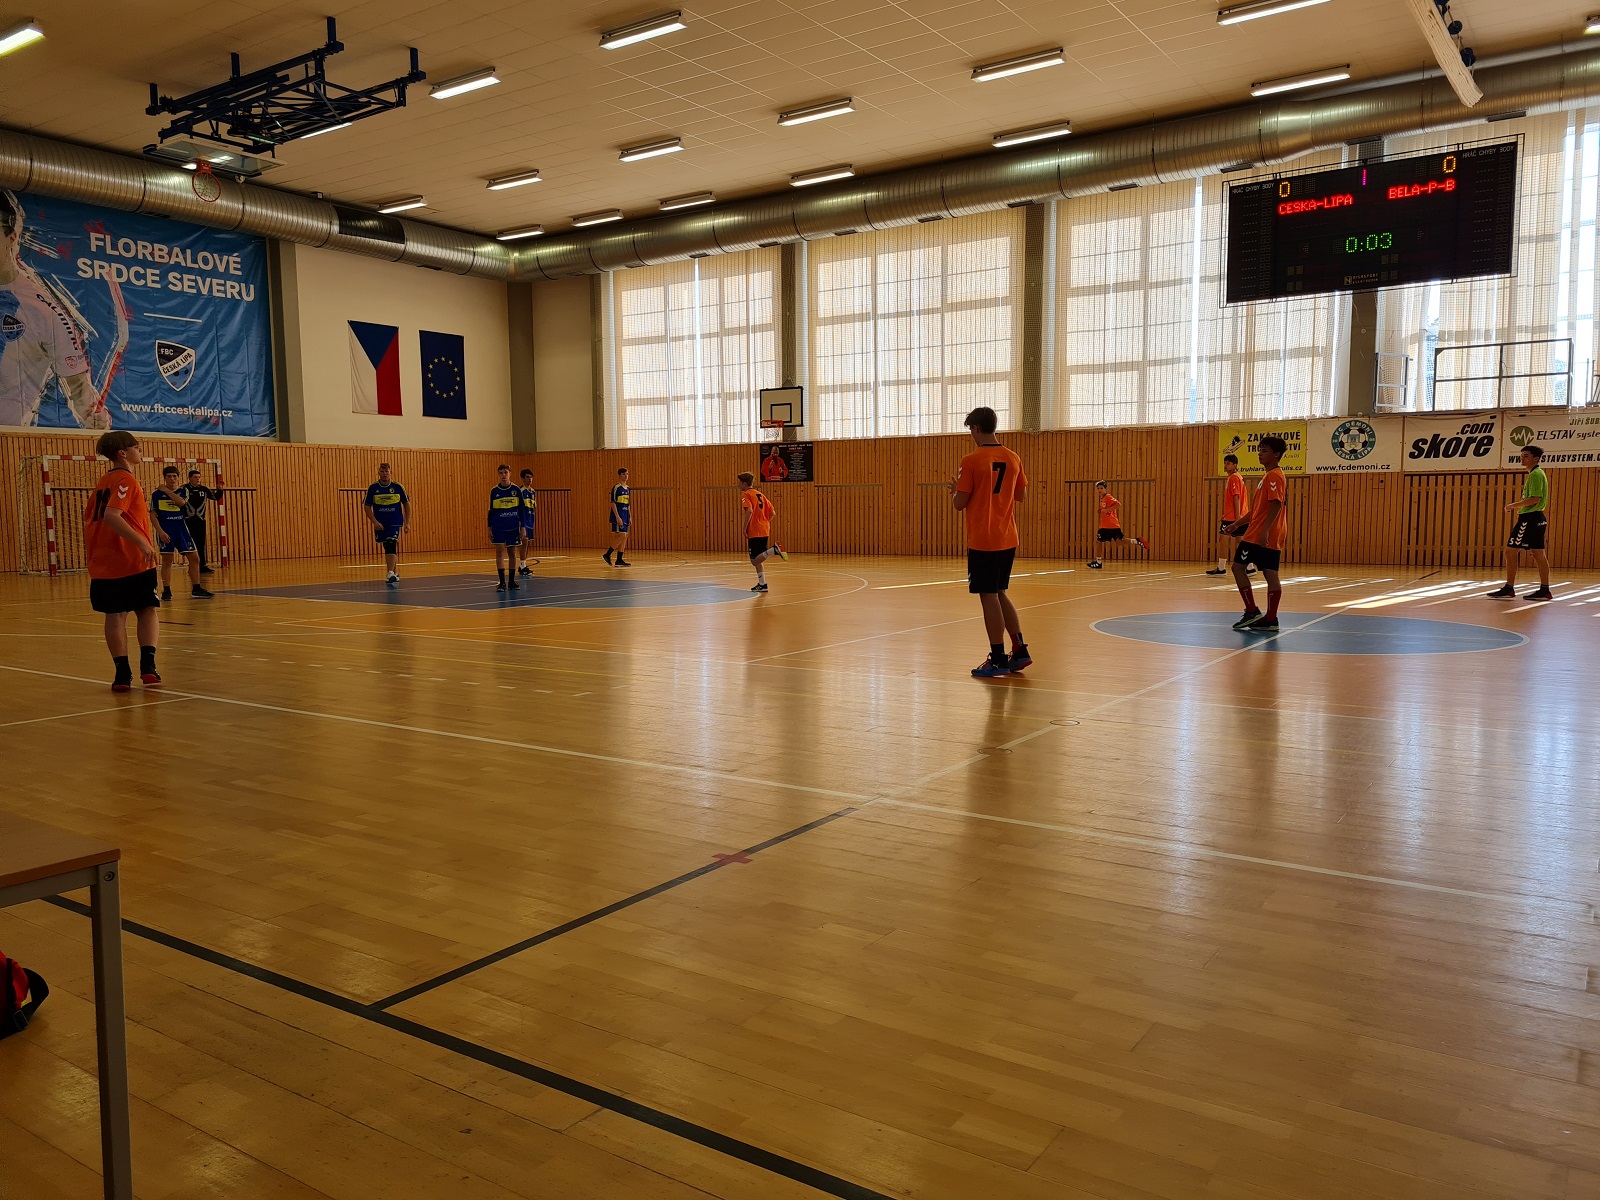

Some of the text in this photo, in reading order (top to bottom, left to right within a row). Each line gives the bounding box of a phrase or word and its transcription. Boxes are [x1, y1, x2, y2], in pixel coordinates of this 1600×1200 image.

[1443, 155, 1457, 174] 0
[1278, 181, 1291, 198] 0
[1387, 178, 1457, 200] BELA-P-B
[1278, 193, 1354, 215] CESKA-LIPA
[1345, 231, 1393, 253] 0:03
[89, 231, 243, 276] FLORBALOVÉ
[76, 257, 256, 302] SRDCE SEVERU
[160, 347, 174, 356] FBC
[162, 352, 193, 375] ČESKÁ LÍPA
[121, 403, 233, 418] www.fbcceskalipa.cz
[1456, 422, 1495, 435] .com
[1536, 429, 1576, 440] ELSTAV
[1408, 433, 1495, 459] skore
[992, 461, 1007, 494] 7
[1316, 462, 1391, 472] www.fcdemoni.cz
